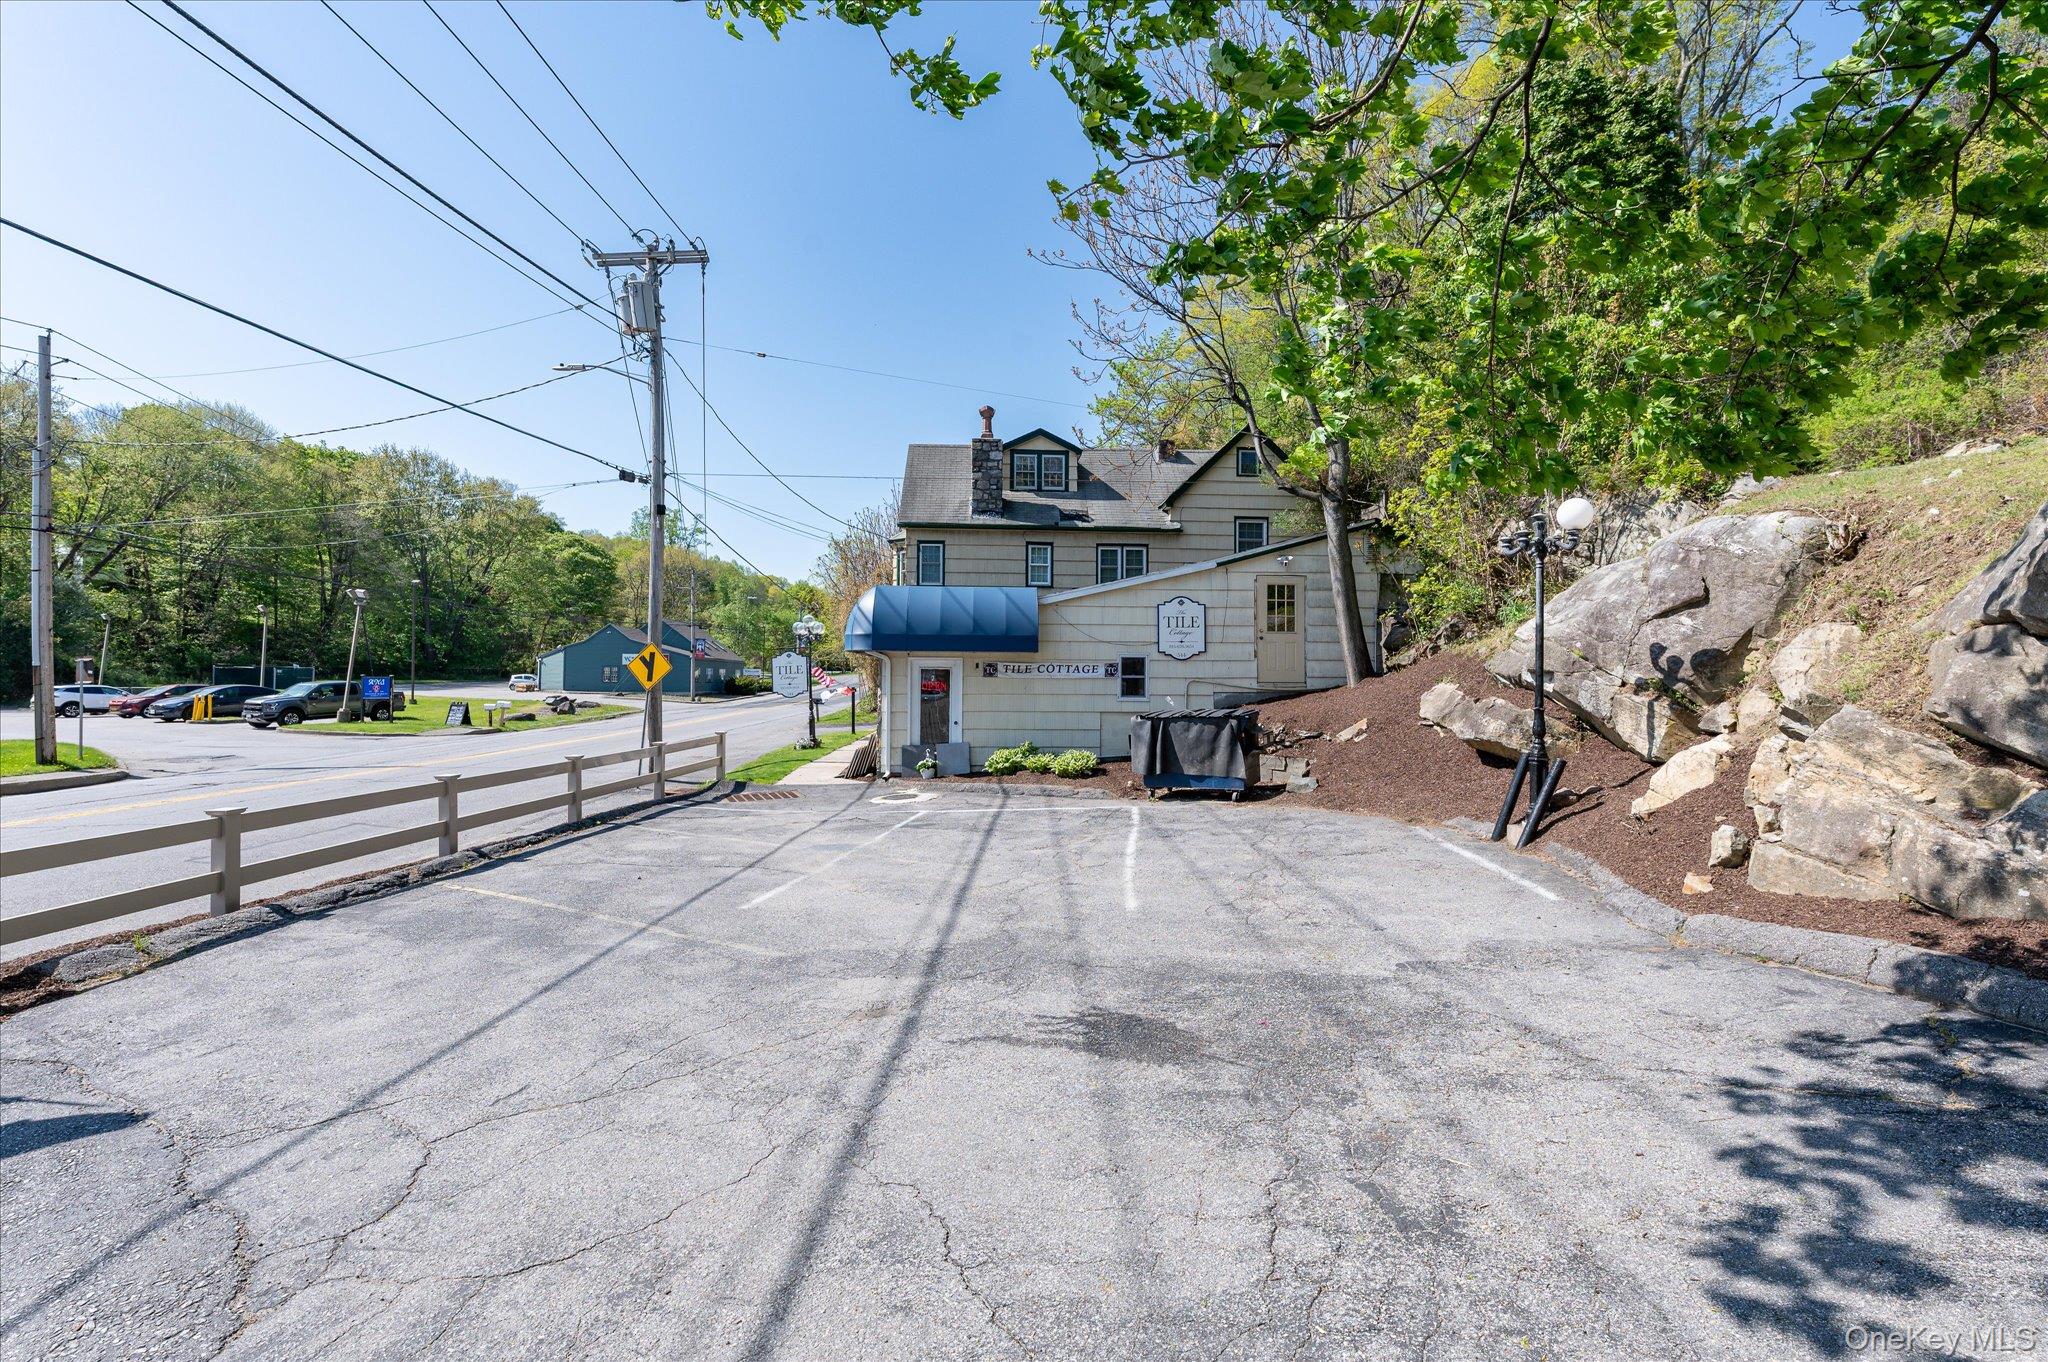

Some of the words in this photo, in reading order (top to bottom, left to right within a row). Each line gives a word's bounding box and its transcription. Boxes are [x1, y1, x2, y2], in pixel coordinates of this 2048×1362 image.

[1163, 615, 1200, 628] TILE
[1168, 628, 1193, 640] Cottage
[775, 665, 804, 675] TILE
[985, 666, 996, 674] TC
[1003, 664, 1032, 674] TILE
[1037, 664, 1099, 674] COTTAGE
[1106, 666, 1118, 674] TC
[922, 681, 947, 691] OPEN
